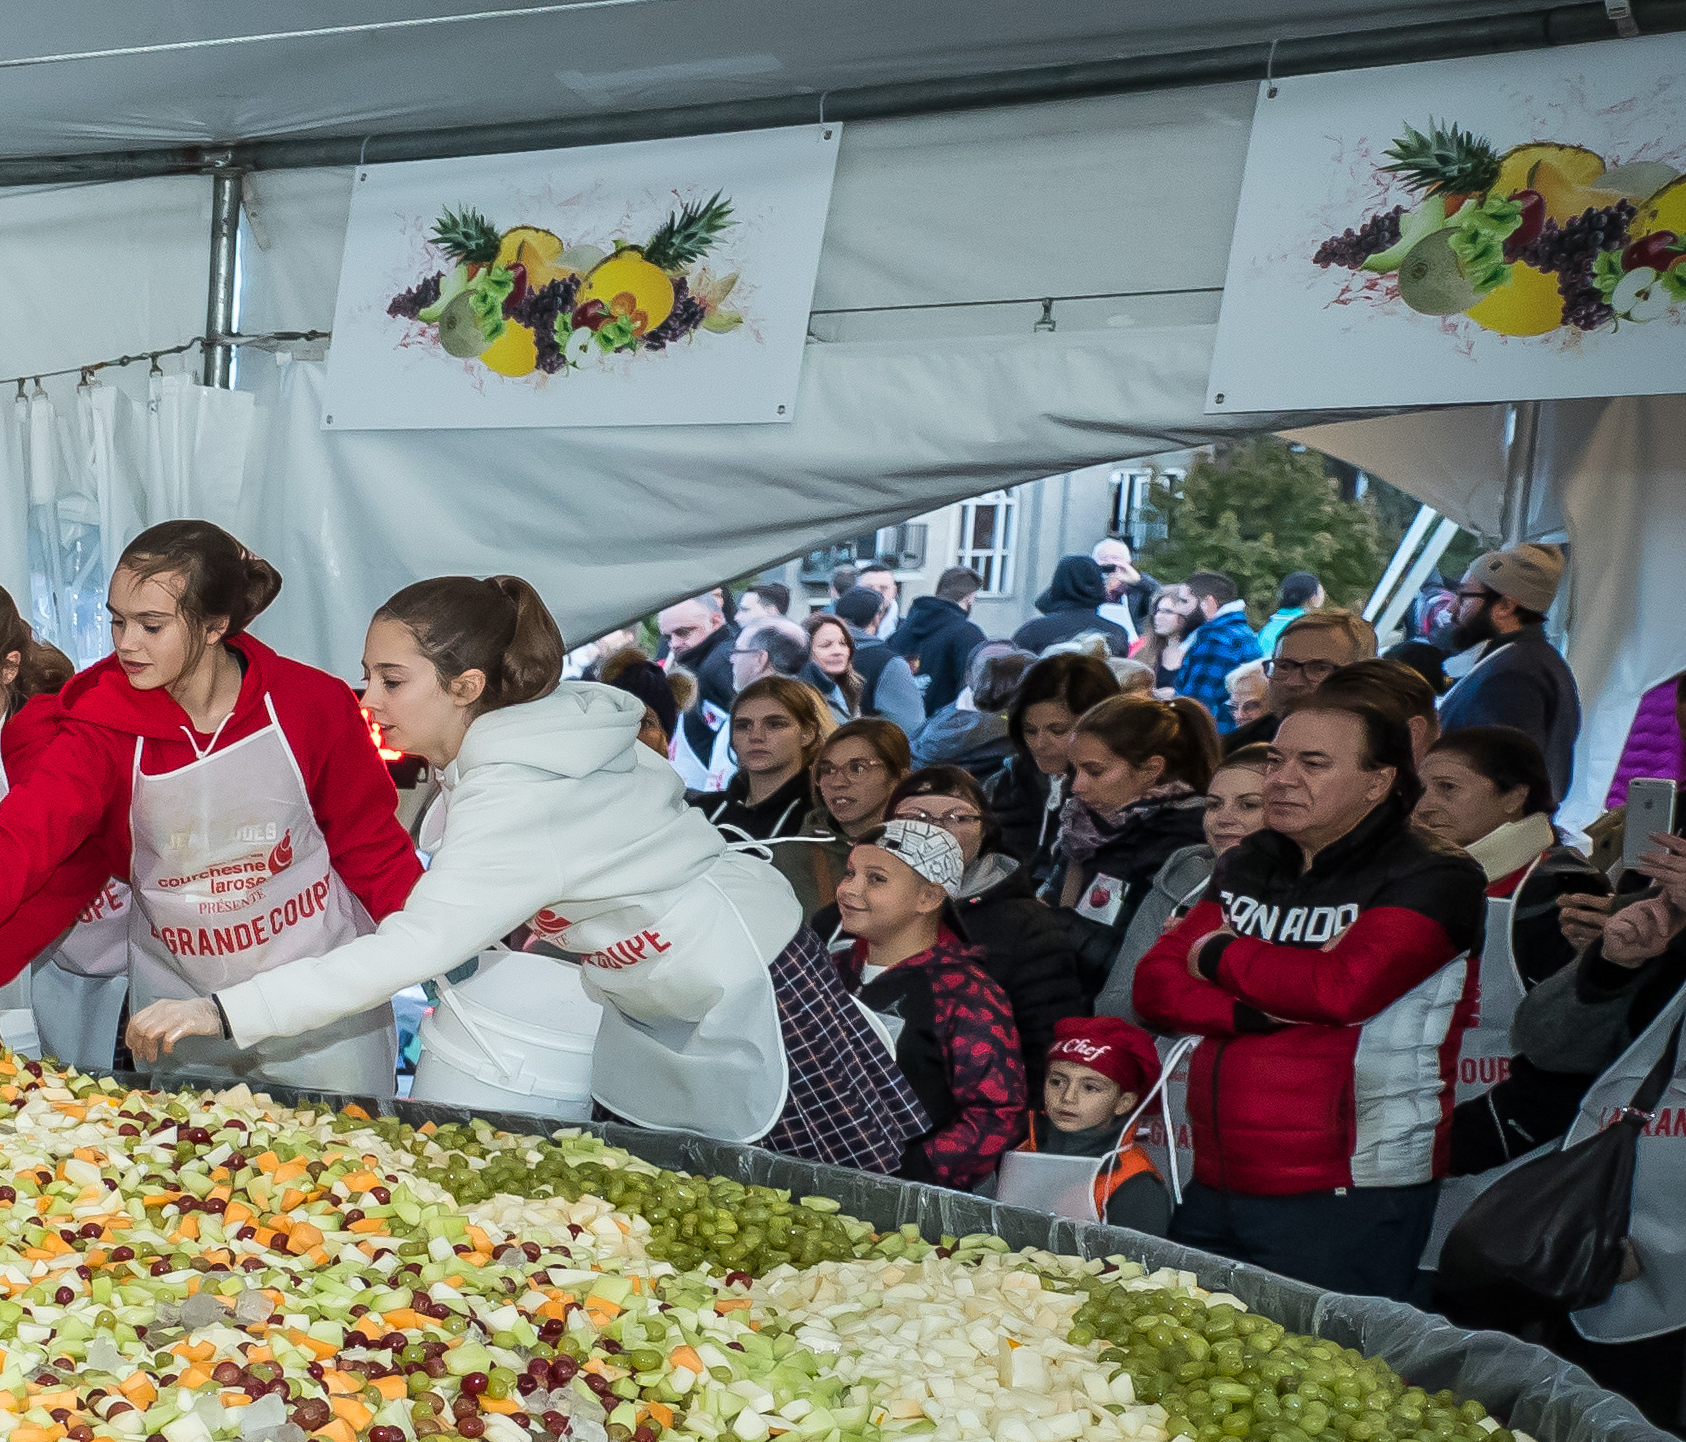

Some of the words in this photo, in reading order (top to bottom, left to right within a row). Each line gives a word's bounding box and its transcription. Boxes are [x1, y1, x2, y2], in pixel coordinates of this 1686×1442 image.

[157, 861, 267, 889] courchesne
[209, 876, 267, 895] larose
[161, 915, 270, 957] GRANDE
[269, 872, 331, 936] COUP
[198, 888, 267, 915] PRÉSENTE
